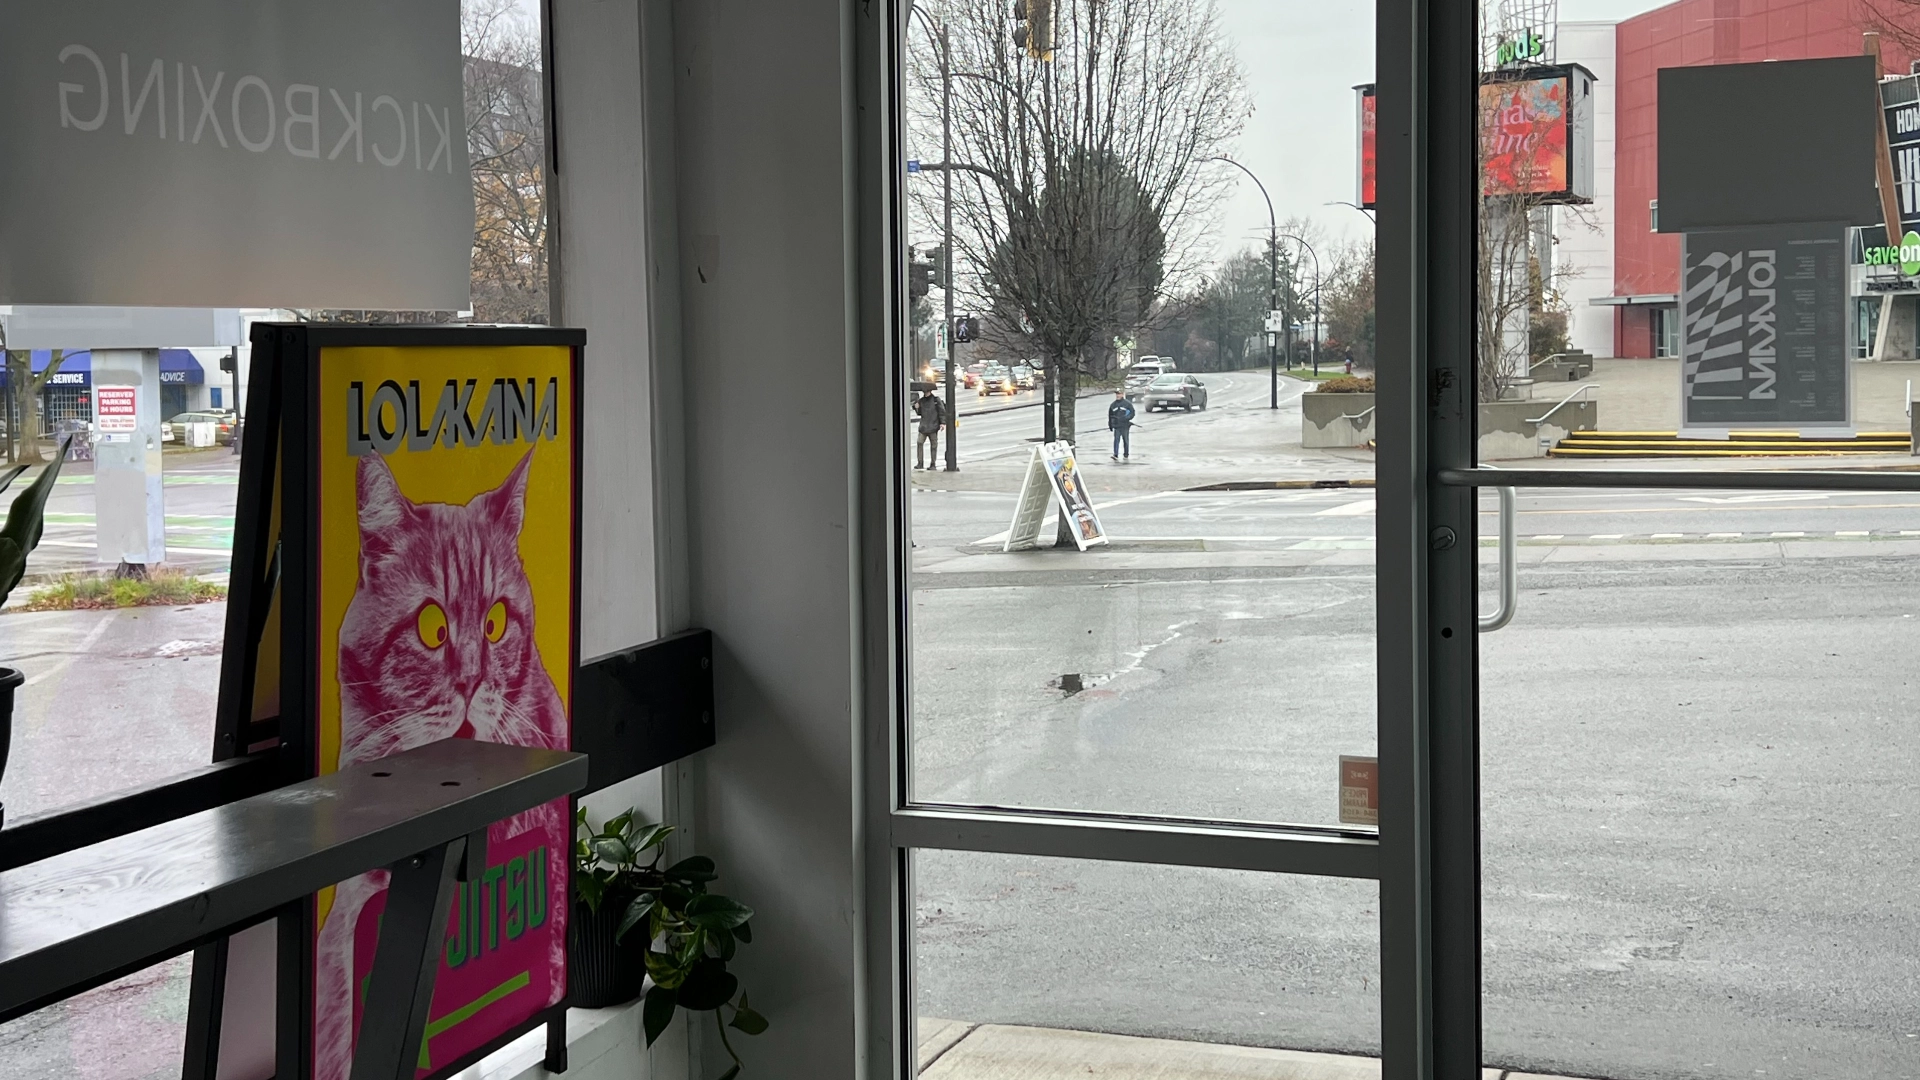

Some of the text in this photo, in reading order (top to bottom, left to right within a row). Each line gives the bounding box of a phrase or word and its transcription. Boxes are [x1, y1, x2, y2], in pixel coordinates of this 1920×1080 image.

[53, 373, 84, 384] SERVICE
[160, 372, 185, 382] ADVICE
[347, 376, 558, 457] LOLAKANA
[447, 846, 547, 968] JITSU
